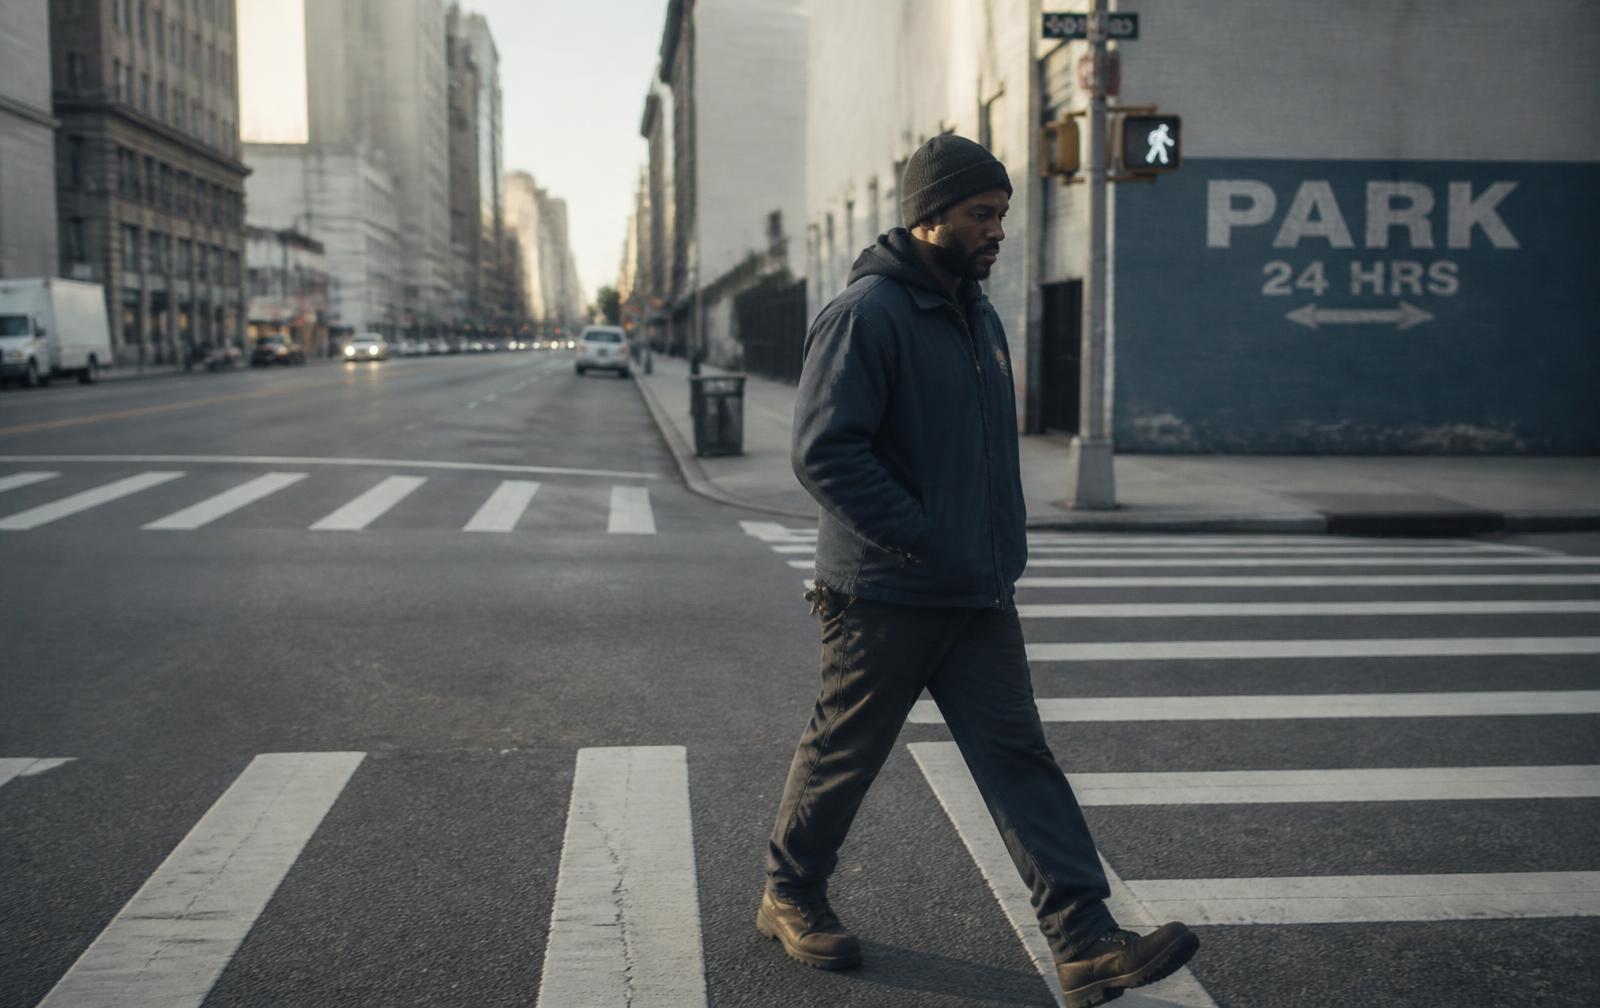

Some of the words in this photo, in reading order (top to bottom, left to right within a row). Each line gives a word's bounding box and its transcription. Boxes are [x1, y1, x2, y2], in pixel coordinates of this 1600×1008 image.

[1207, 180, 1519, 249] PARK
[1262, 261, 1328, 296] 24
[1350, 261, 1460, 296] HRS
